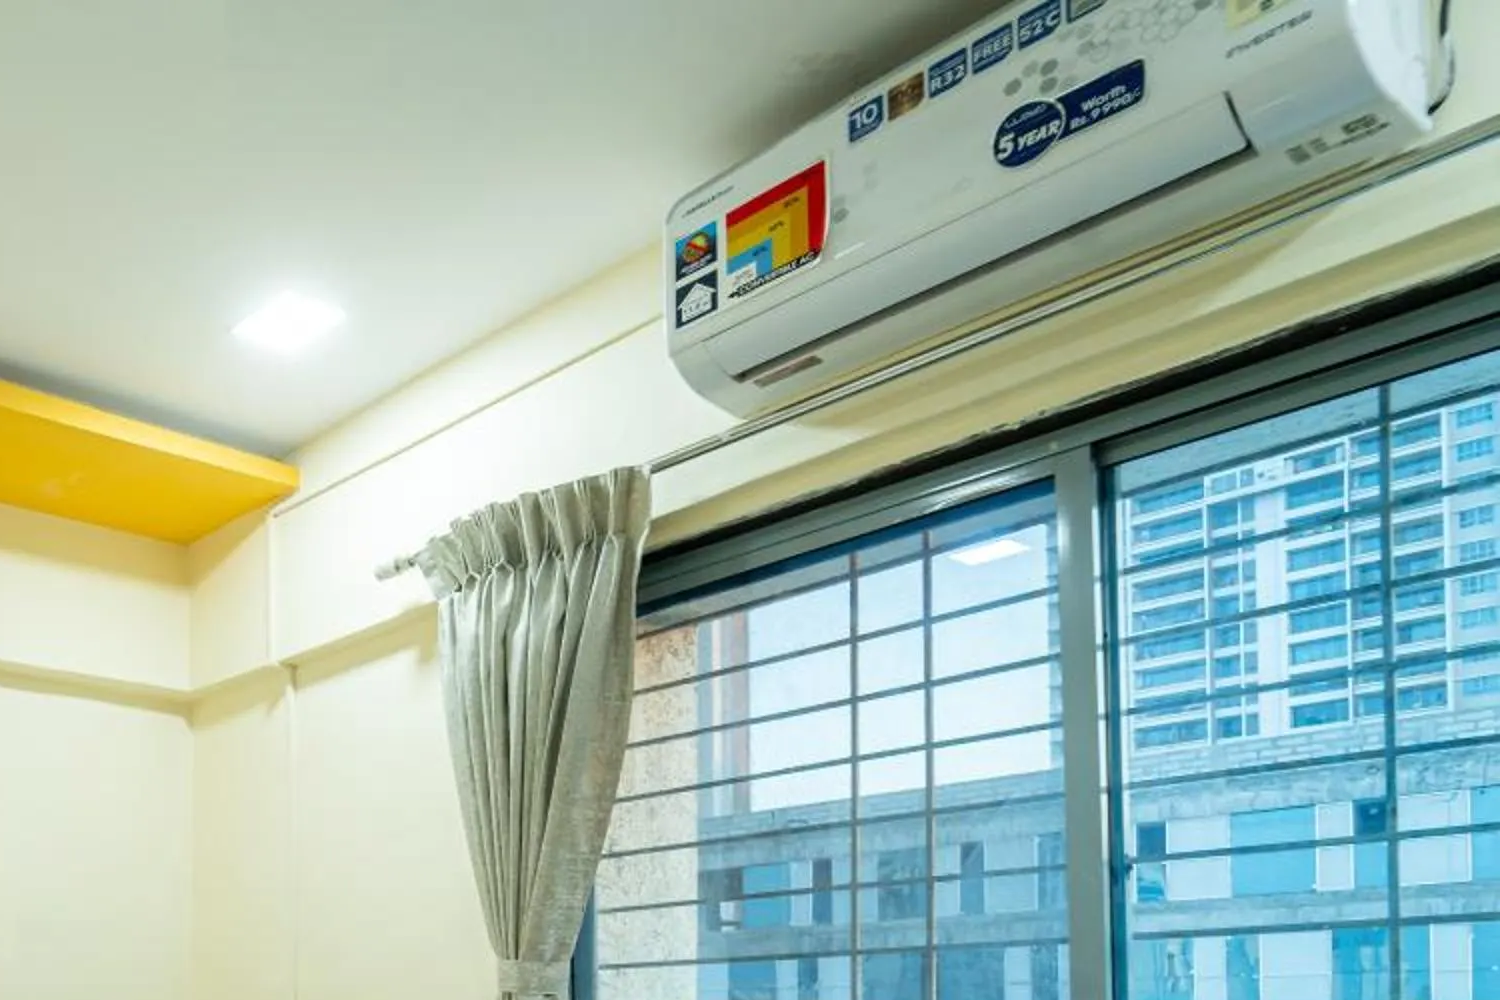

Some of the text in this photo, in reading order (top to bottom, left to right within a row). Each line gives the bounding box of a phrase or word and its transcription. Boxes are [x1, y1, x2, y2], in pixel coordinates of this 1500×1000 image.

[974, 34, 1013, 62] FREE
[931, 64, 965, 94] R32
[1081, 84, 1127, 112] Worth
[851, 104, 877, 129] 10
[996, 131, 1017, 161] 5
[1017, 119, 1062, 150] YEAR
